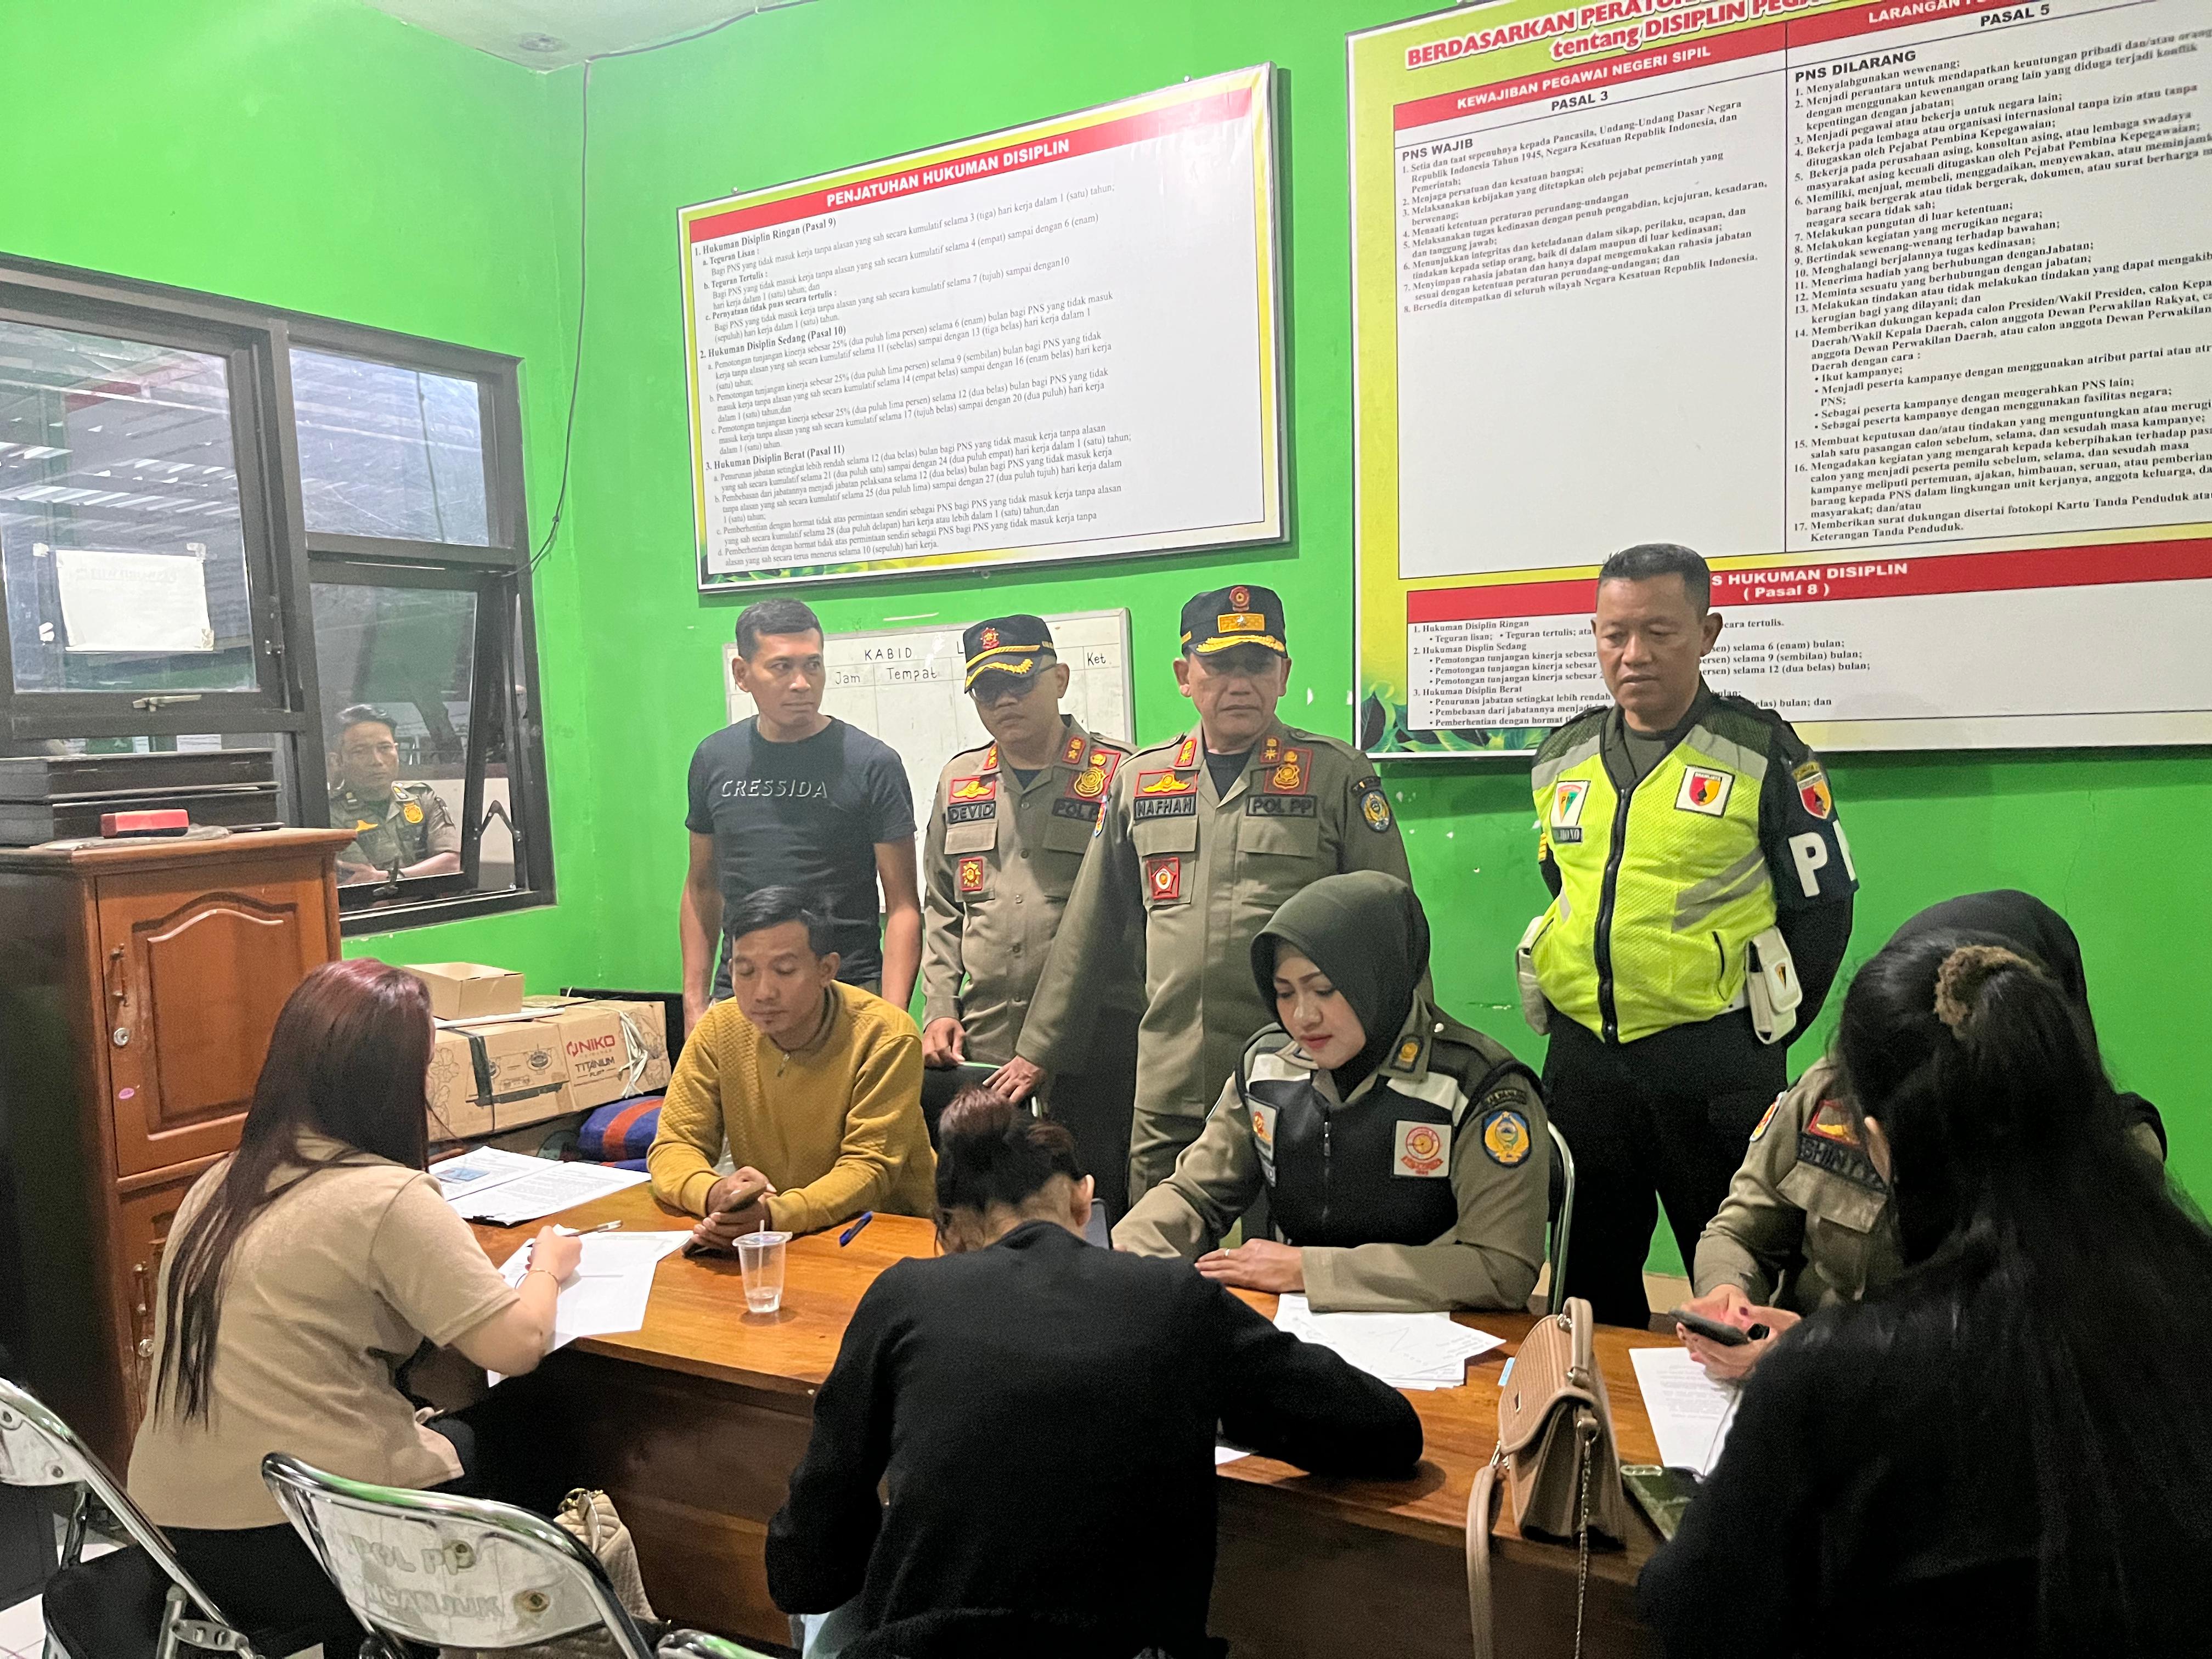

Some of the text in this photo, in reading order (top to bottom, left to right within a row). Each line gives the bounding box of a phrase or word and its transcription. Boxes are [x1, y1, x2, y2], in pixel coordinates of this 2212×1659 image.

[1869, 0, 1960, 23] LARANGAN
[1980, 3, 2050, 27] PASAL 5
[1407, 13, 1575, 65] BERDASARKAN
[1554, 25, 1639, 58] tentang
[1645, 2, 1745, 37] DISIPLIN
[1795, 50, 1916, 82] PNS DILARANG
[1807, 71, 1899, 94] Menyalahgunakan
[1903, 60, 1960, 76] wewenang;
[1457, 46, 1711, 109] KEWAJIBAN PEGAWAI NEGERI SIPIL
[1551, 91, 1608, 111] PASAL 3
[1807, 127, 1848, 143] Menjadi
[1852, 120, 1893, 137] pegawai
[1895, 117, 1917, 127] atau
[1921, 109, 1961, 123] bekerja
[1964, 103, 1995, 115] untuk
[1999, 98, 2035, 110] negara
[2038, 93, 2062, 104] lain;
[1402, 138, 1473, 161] PNS WAJIB
[827, 138, 1069, 207] PENJATUHAN HUKUMAN DISIPLIN
[1412, 193, 1447, 205] Menjaga
[1449, 184, 1489, 200] persatuan
[1492, 181, 1508, 189] dan
[1510, 173, 1548, 186] kesatuan
[1550, 167, 1584, 178] bangsa;
[1412, 223, 1445, 237] Menaati
[1447, 218, 1488, 230] ketentuan
[1490, 210, 1532, 225] peraturan
[1534, 193, 1629, 217] perundang-undangan
[1807, 225, 1863, 240] Melakukan
[1866, 217, 1915, 233] pungutan
[1918, 213, 1928, 223] di
[1932, 211, 1954, 221] luar
[1956, 202, 2013, 217] ketentuan;
[703, 241, 740, 255] Hukuman
[741, 232, 770, 246] Disiplin
[772, 227, 800, 239] Ringan
[802, 220, 826, 234] (Pasal
[1796, 237, 2035, 278] 10. Menghalangi berjalannya tugas kedinasan;
[1413, 300, 1447, 312] Bersedia
[1449, 293, 1501, 306] ditempatkan
[1514, 285, 1545, 296] seluruh
[1548, 279, 1582, 291] wilayah
[1584, 276, 1616, 286] Negara
[1619, 269, 1661, 281] Kesatuan
[1664, 261, 1706, 274] Republik
[1709, 253, 1758, 267] Indonesia.
[708, 345, 745, 358] Hukuman
[747, 338, 776, 351] Disiplin
[778, 334, 806, 346] Sedang
[808, 327, 832, 342] (Pasal
[834, 325, 846, 336] 10)
[1822, 366, 1903, 381] Ikut kampanye;
[1821, 378, 2134, 419] Sebagai peserta kampanye dengan mengerahkan PNS lain;
[1821, 396, 1846, 407] PNS;
[714, 459, 751, 470] Hukuman
[753, 453, 782, 465] Disiplin
[784, 450, 805, 461] Berat
[807, 445, 831, 460] (Pasal
[1810, 522, 1963, 542] Keterangan Tanda Penduduk.
[1729, 569, 1820, 585] HUKUMAN
[1827, 563, 1908, 579] DISIPLIN
[1423, 624, 1463, 633] Hukuman
[1465, 621, 1497, 631] Disiplin
[1499, 620, 1529, 629] Ringan
[1747, 618, 1784, 628] tertulis.
[1435, 635, 1468, 644] Teguran
[1505, 631, 1540, 640] Teguran
[1543, 628, 1576, 637] tertulis;
[865, 647, 912, 661] KABID
[1465, 644, 1494, 653] Displin
[1496, 642, 1527, 651] Sedang
[1087, 652, 1106, 666] Ket
[1701, 662, 1870, 676] ersen) selama 12 (dua belas) bulan;
[836, 667, 938, 684] Jam Tempat
[1423, 688, 1463, 696] Hukuman
[1465, 686, 1497, 696] Disiplin
[1499, 685, 1522, 693] Berat
[721, 778, 827, 798] CRESSIDA
[950, 804, 994, 820] DEVID
[1059, 802, 1085, 817] POL
[1137, 797, 1192, 816] NAFHAN
[1253, 798, 1312, 813] POL PP
